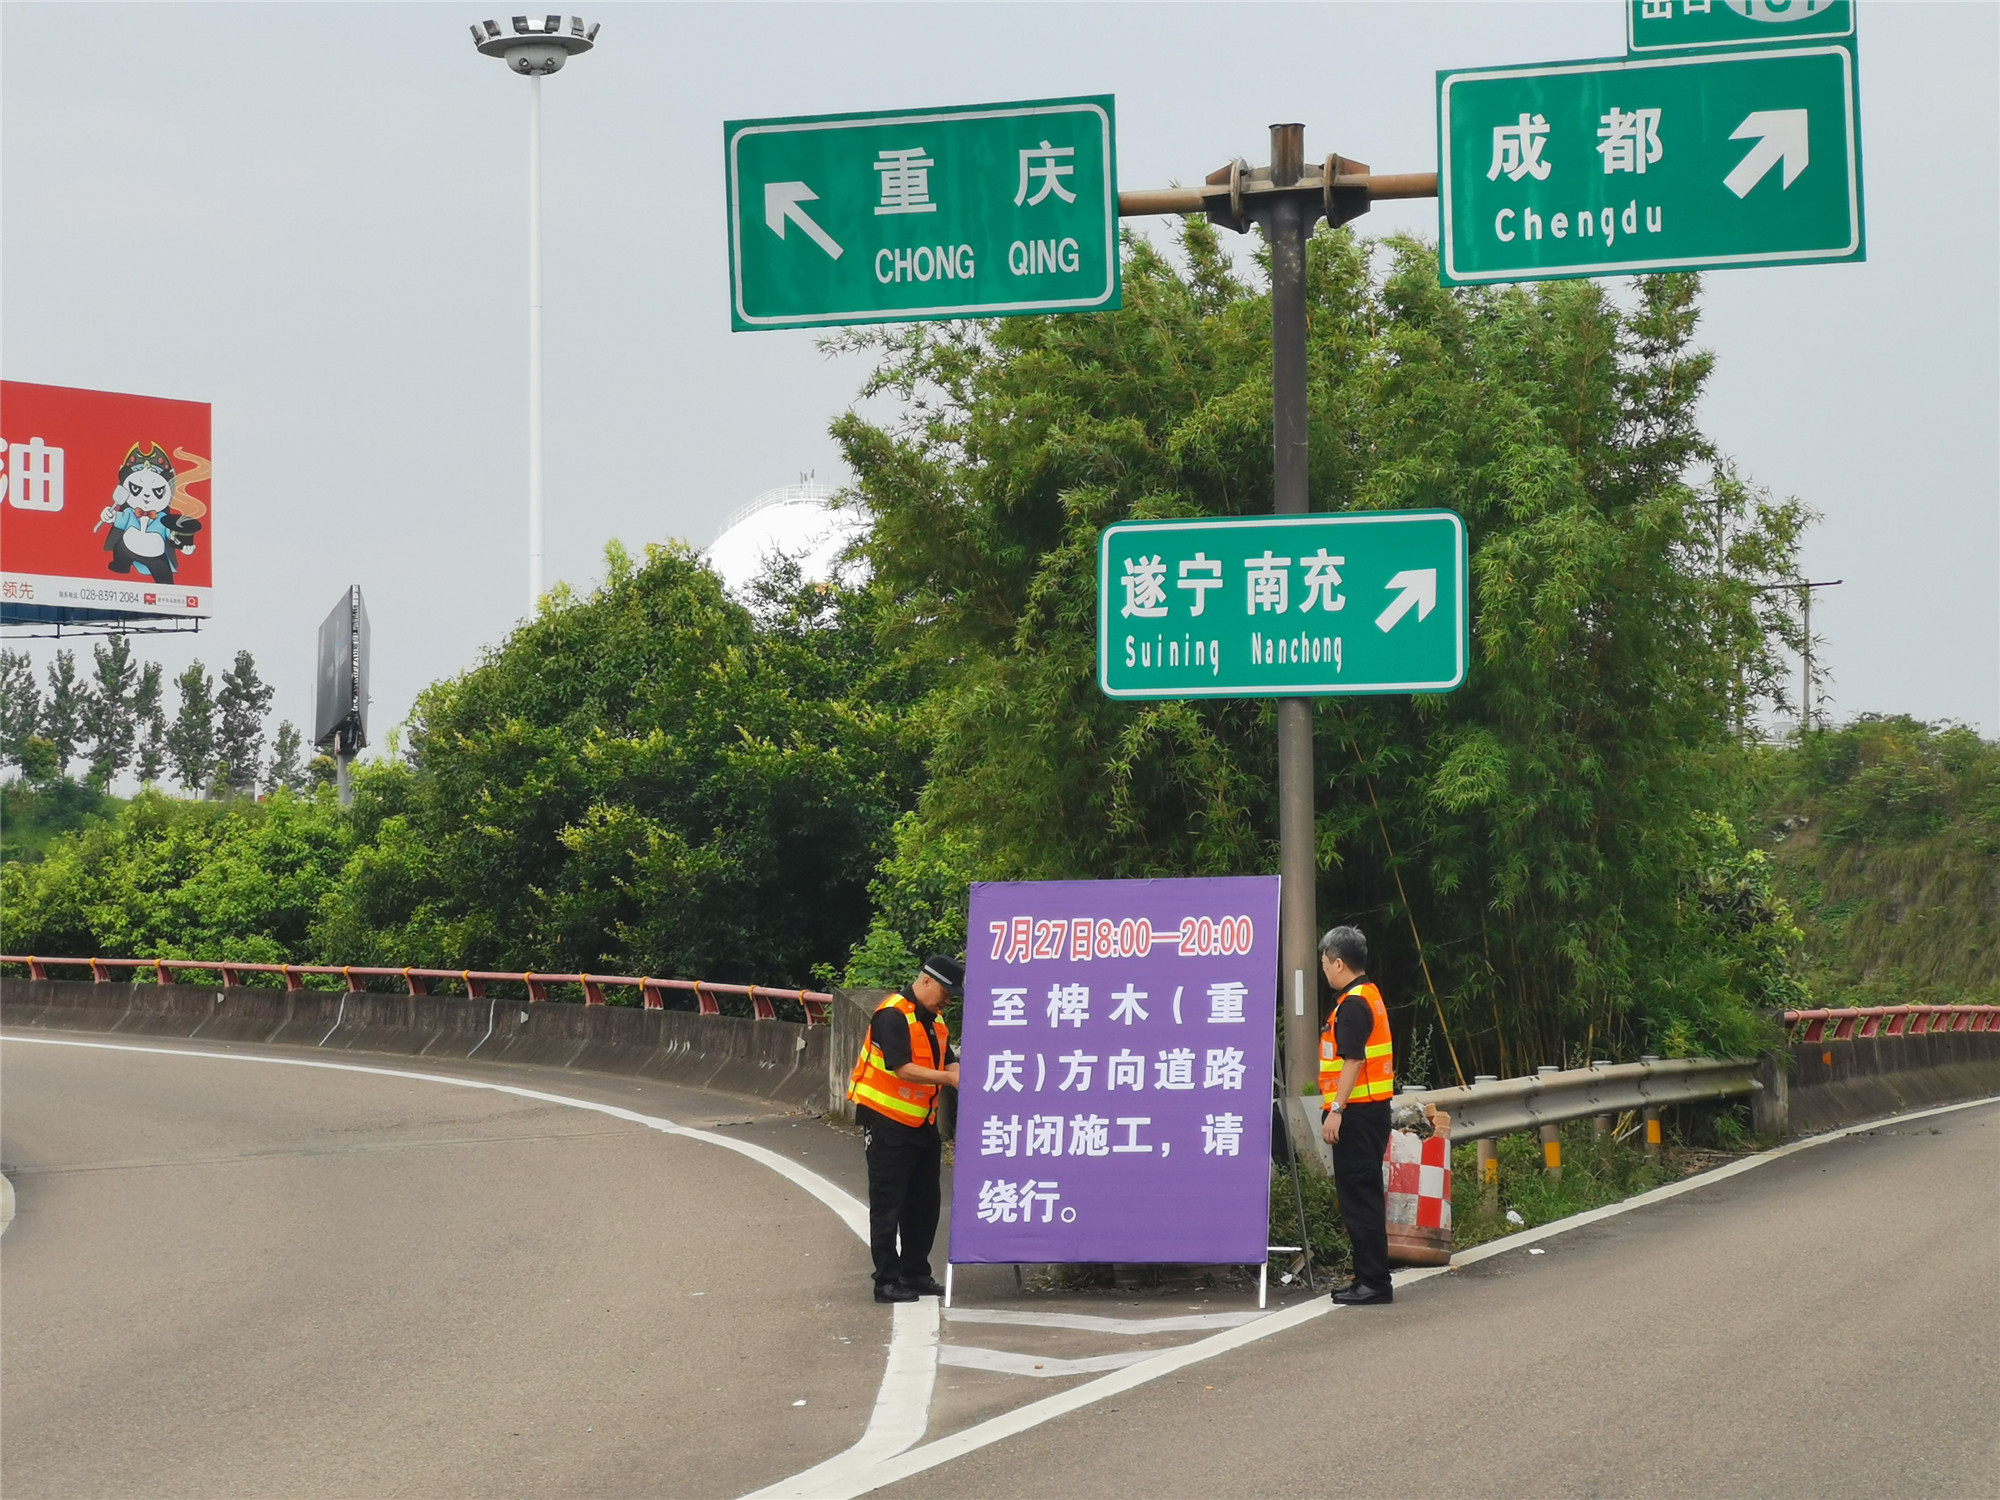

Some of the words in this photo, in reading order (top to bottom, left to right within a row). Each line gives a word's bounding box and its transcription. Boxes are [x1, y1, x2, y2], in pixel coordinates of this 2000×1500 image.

[1487, 107, 1664, 183] 成都
[873, 140, 1077, 215] 重庆
[1495, 199, 1663, 247] Chengdu
[875, 244, 975, 284] CHONG
[1008, 237, 1080, 275] QING
[2, 581, 34, 600] 领先
[119, 591, 139, 603] 2084
[1121, 552, 1224, 618] 遂宁
[1244, 548, 1346, 616] 南充
[1125, 633, 1219, 676] Suining
[1252, 631, 1342, 673] Nanchong
[976, 1179, 1077, 1224] 绕行。
